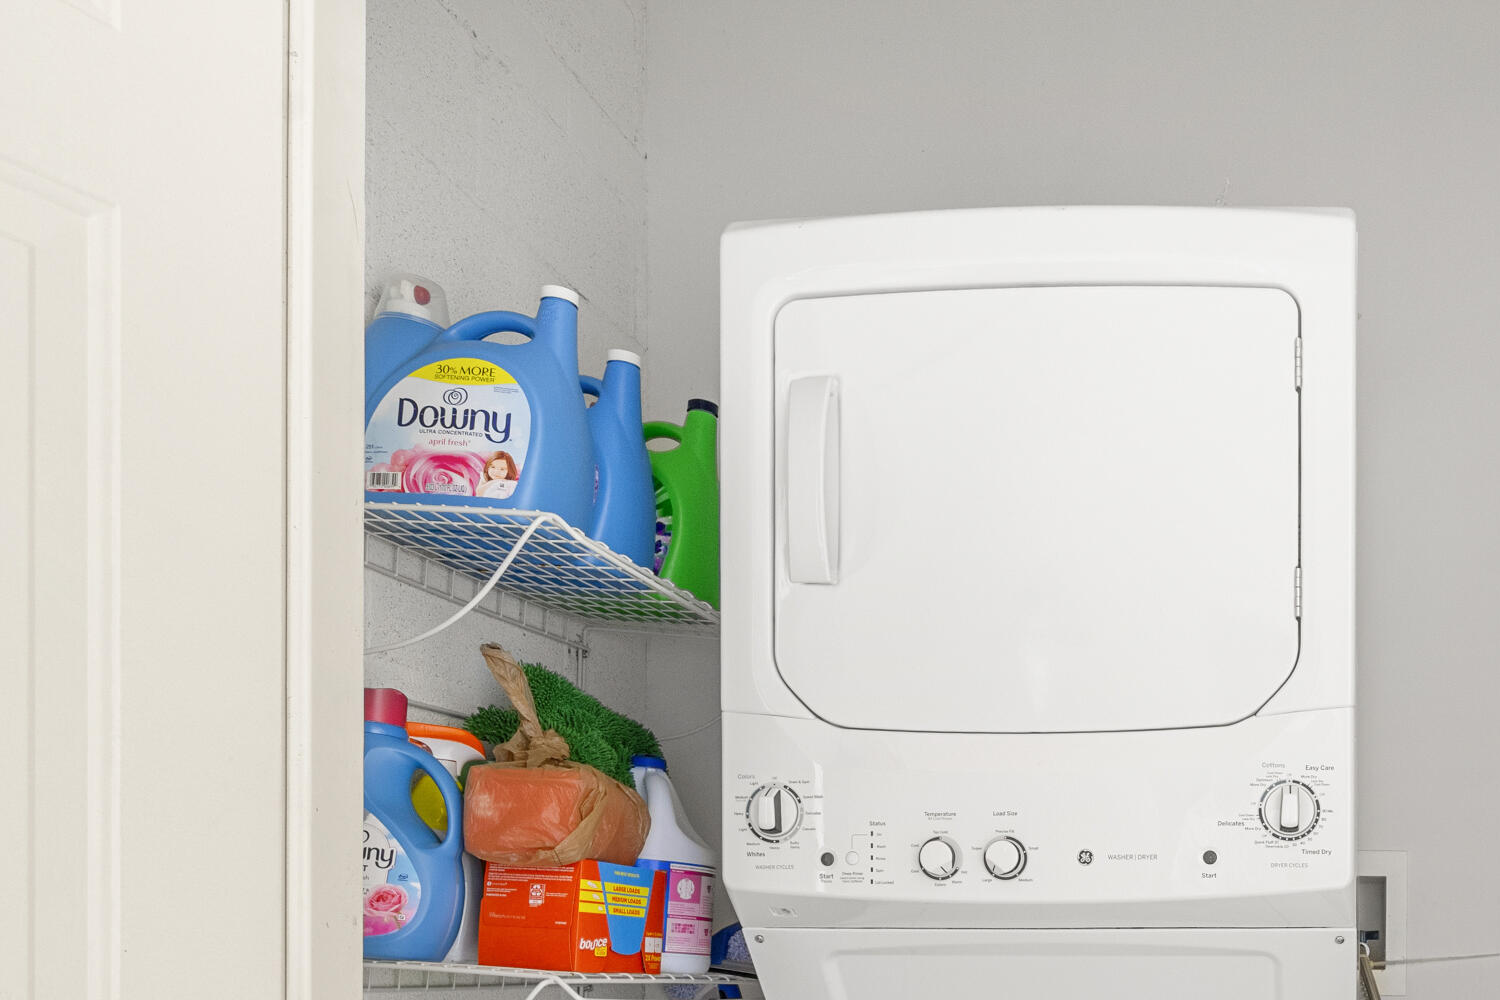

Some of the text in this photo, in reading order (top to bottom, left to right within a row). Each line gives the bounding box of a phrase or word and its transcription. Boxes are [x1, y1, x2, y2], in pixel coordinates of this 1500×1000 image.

[436, 364, 496, 377] 30% MORE
[434, 374, 470, 382] SOFTENING
[397, 398, 512, 443] Downy
[438, 429, 483, 437] CONCENTRATED
[579, 938, 608, 950] bounce
